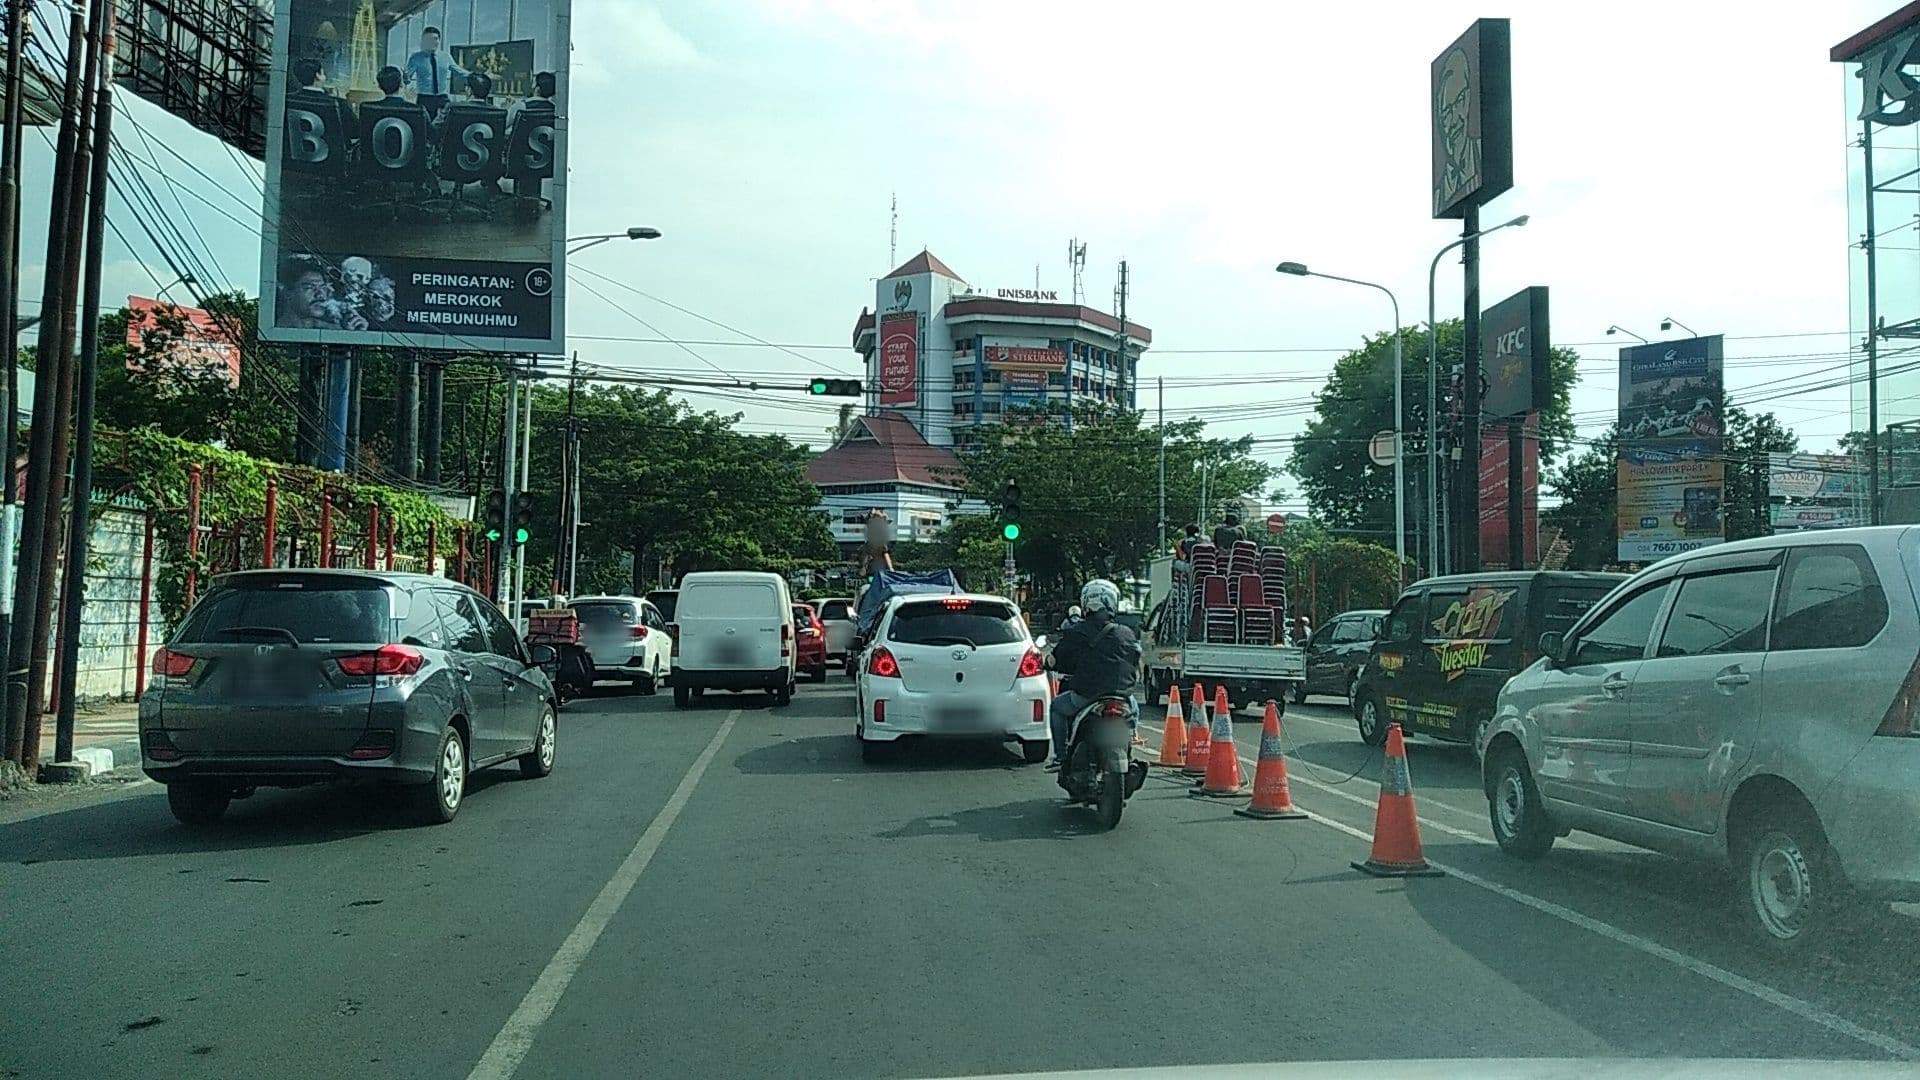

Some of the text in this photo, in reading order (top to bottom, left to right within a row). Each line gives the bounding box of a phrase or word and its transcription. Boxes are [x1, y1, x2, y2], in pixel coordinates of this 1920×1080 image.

[287, 109, 554, 172] BOSS
[412, 272, 515, 289] PERINGATAN:
[533, 276, 548, 287] 18+
[424, 292, 502, 308] MEROKOK
[997, 288, 1058, 301] UNISBANK
[407, 310, 518, 327] MEMBUNUHMU
[887, 342, 909, 353] START
[1496, 326, 1526, 359] KFC
[888, 354, 907, 365] YOUR
[885, 365, 910, 376] FUTURE
[1630, 463, 1680, 475] HALLOWEEN
[1652, 543, 1676, 552] 7667
[1440, 639, 1486, 673] Tuesday
